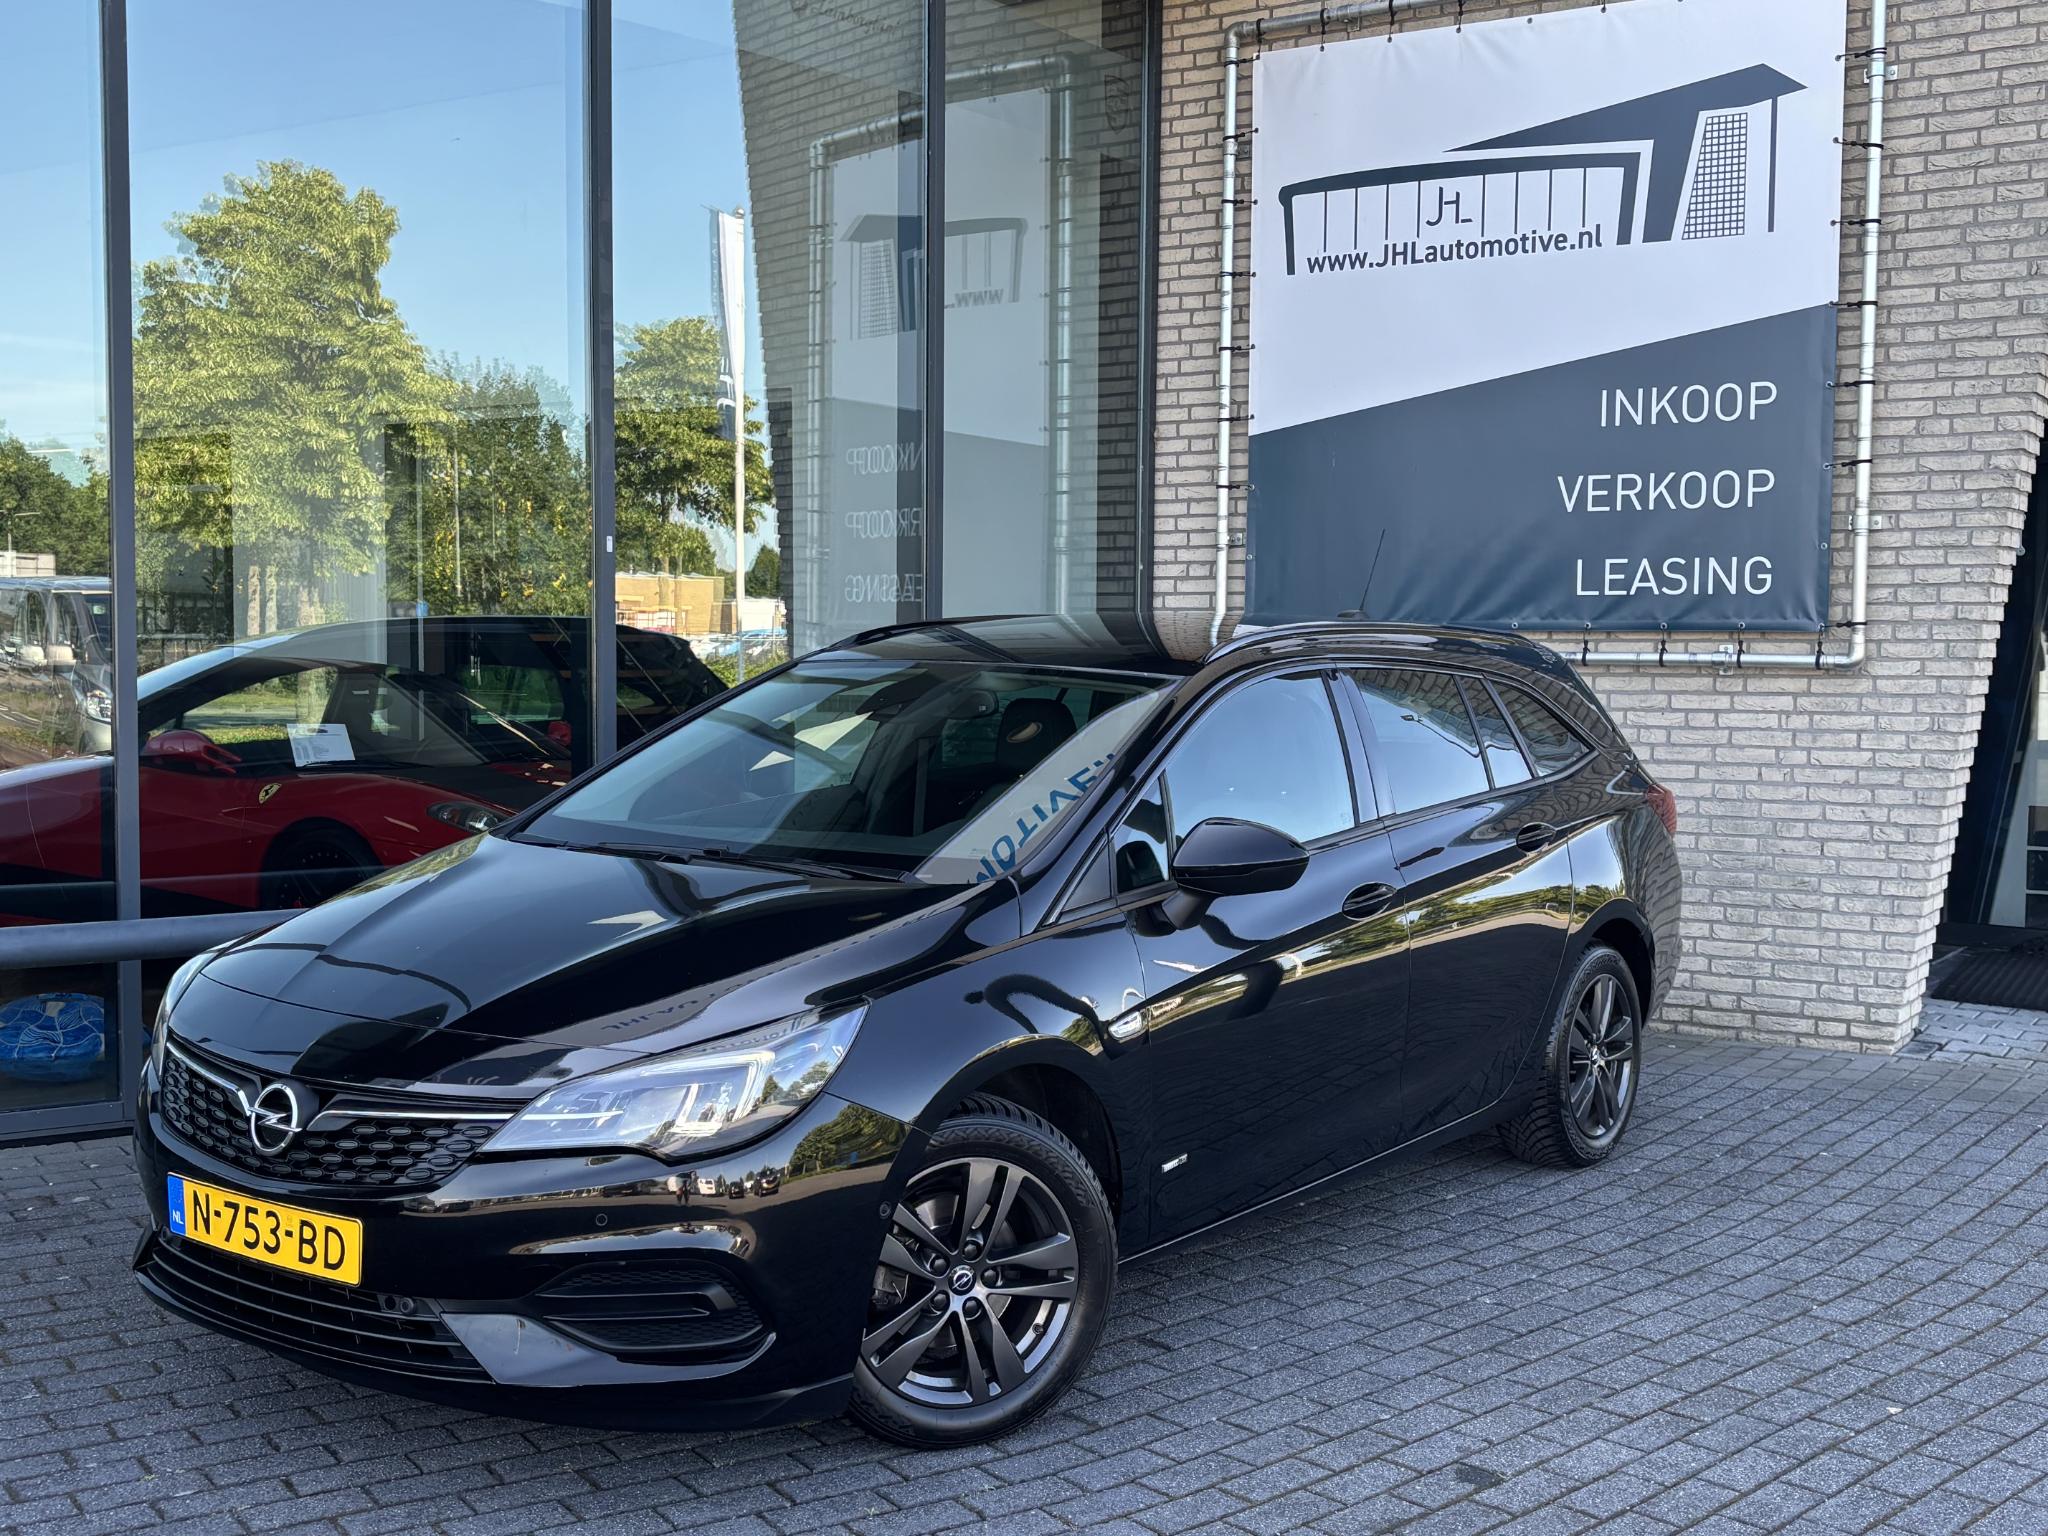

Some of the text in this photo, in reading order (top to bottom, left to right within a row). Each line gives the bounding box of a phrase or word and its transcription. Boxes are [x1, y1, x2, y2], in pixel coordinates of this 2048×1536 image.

[1426, 186, 1473, 226] JHL
[1306, 224, 1603, 274] www.JHLautomotive.nl
[1600, 381, 1778, 427] INKOOP
[1557, 469, 1776, 513] VERKOOP
[1576, 556, 1773, 597] LEASING
[172, 1210, 184, 1225] NL
[192, 1190, 346, 1272] N-753-BD
